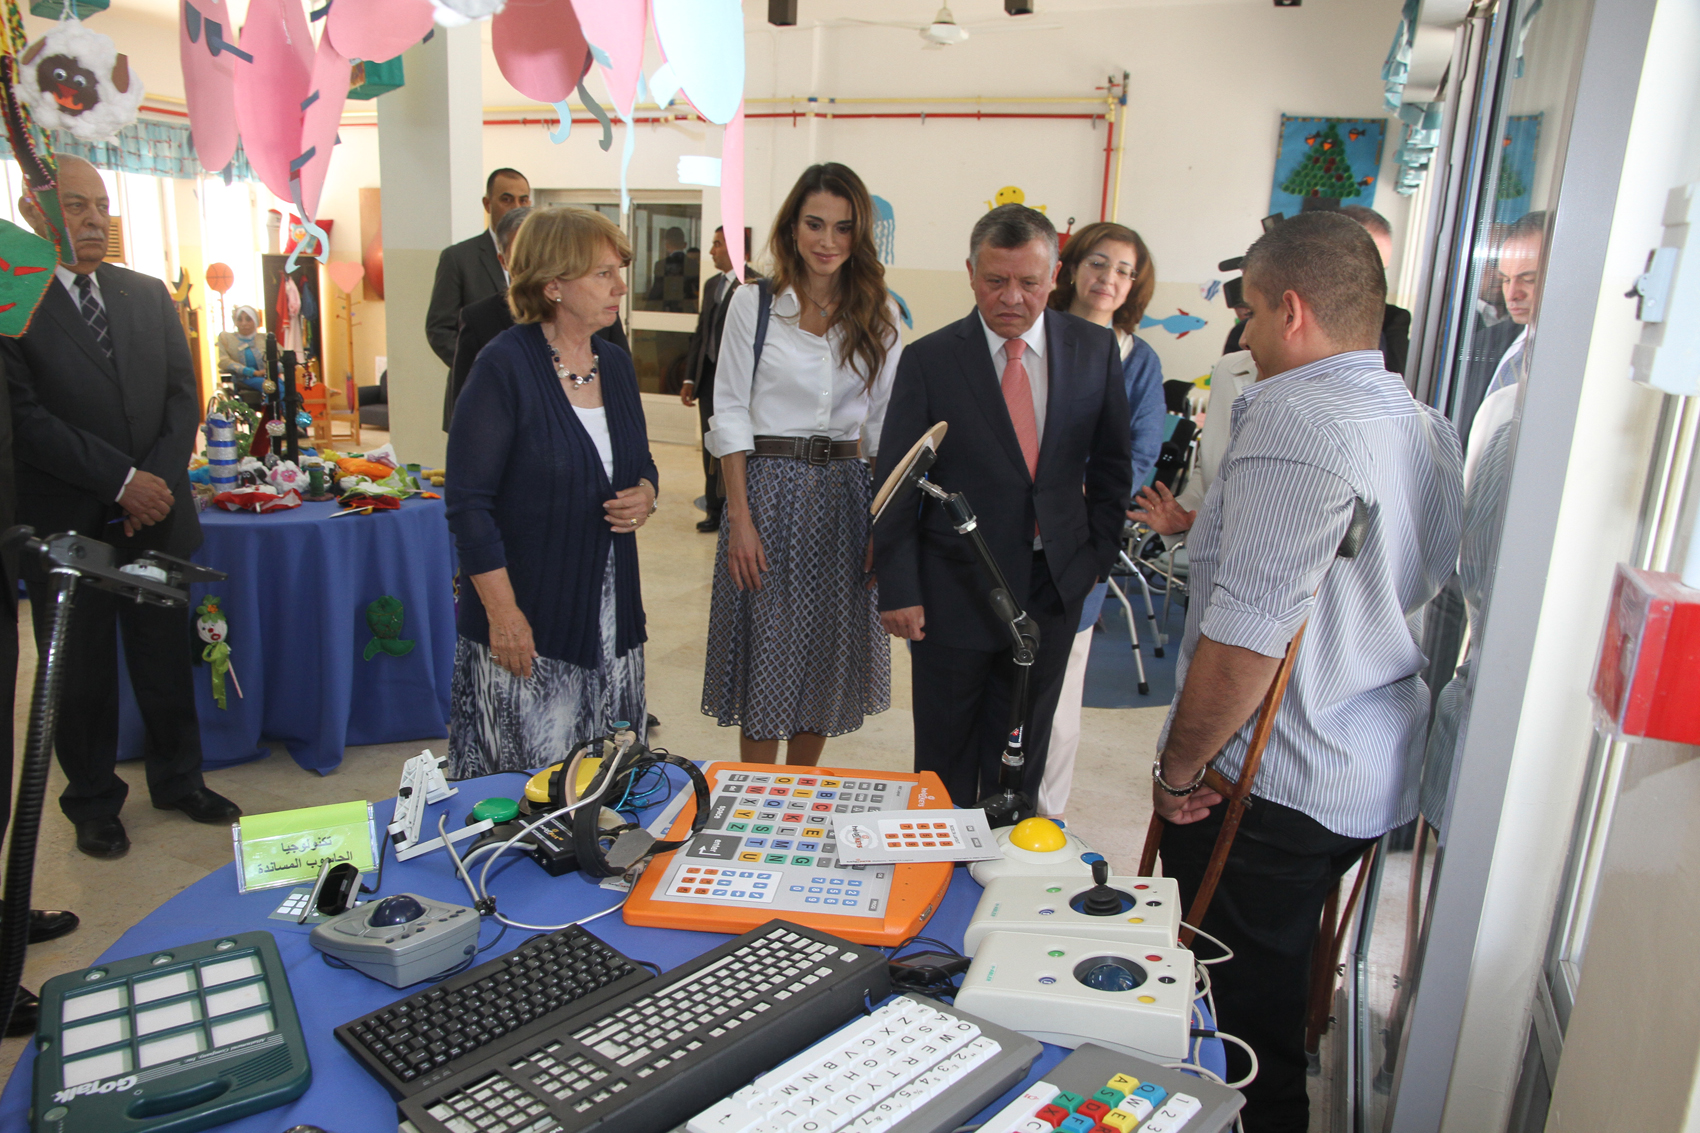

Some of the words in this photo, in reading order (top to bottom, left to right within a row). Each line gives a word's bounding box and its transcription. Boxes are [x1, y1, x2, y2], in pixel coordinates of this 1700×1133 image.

[714, 805, 726, 819] space
[281, 836, 332, 854] تكنولوجيا
[710, 839, 721, 852] enter
[258, 858, 301, 874] المساندة
[880, 1027, 895, 1036] X
[939, 1034, 955, 1043] W
[886, 1048, 897, 1056] F
[921, 1045, 937, 1054] E
[902, 1057, 919, 1065] R
[802, 1073, 819, 1082] N
[843, 1071, 860, 1080] H
[781, 1085, 799, 1095] M
[867, 1083, 881, 1091] Y
[1140, 1084, 1156, 1093] Q
[803, 1096, 819, 1106] K
[845, 1094, 861, 1104] U
[1059, 1093, 1075, 1102] Z
[1086, 1102, 1101, 1111] D
[1126, 1098, 1143, 1108] W
[1044, 1107, 1059, 1116] X
[1111, 1112, 1126, 1120] E
[1072, 1117, 1084, 1125] F
[803, 1122, 818, 1131] O
[1026, 1121, 1042, 1131] C
[1147, 1124, 1162, 1132] 3
